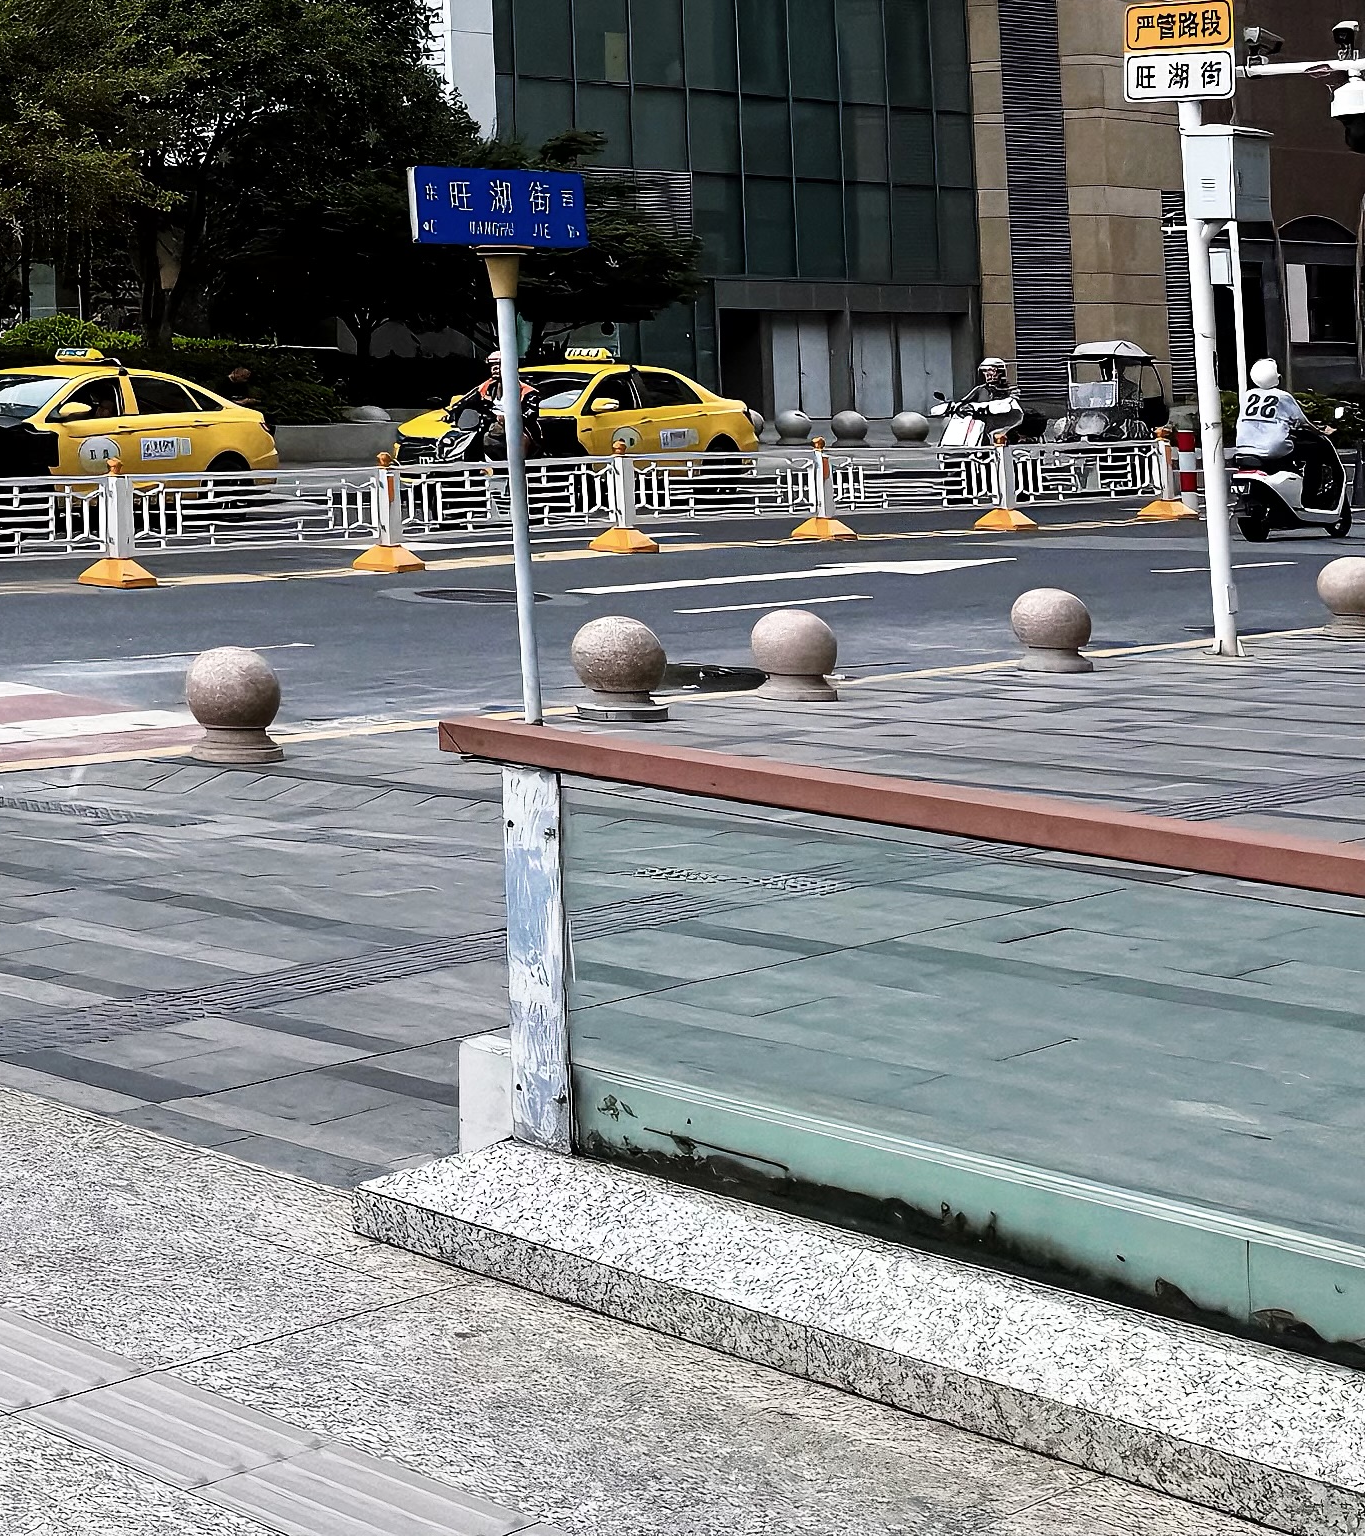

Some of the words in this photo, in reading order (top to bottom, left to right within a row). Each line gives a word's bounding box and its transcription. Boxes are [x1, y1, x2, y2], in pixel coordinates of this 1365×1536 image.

[1134, 9, 1222, 42] 严管路段
[1135, 61, 1222, 89] 旺湖街
[449, 180, 551, 215] 旺湖街
[1245, 393, 1280, 419] 22
